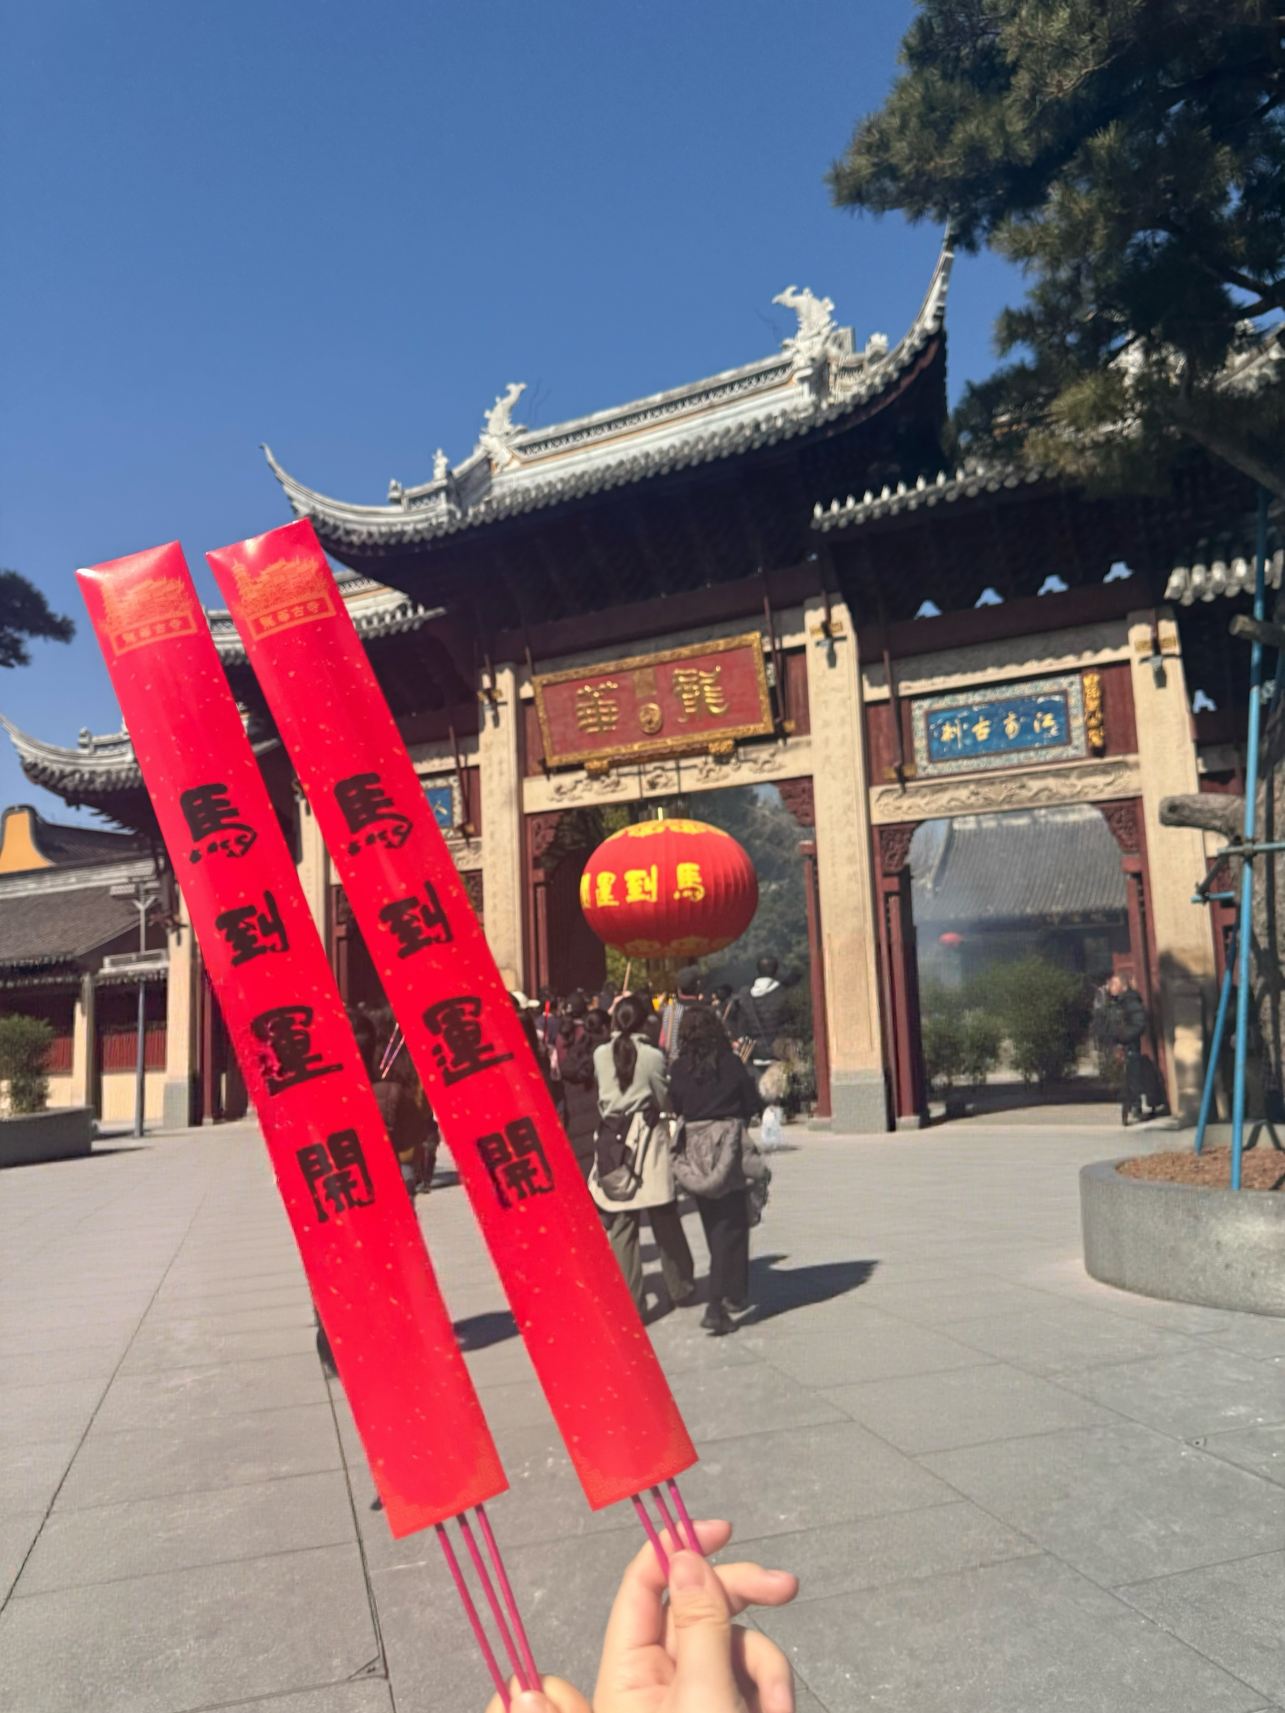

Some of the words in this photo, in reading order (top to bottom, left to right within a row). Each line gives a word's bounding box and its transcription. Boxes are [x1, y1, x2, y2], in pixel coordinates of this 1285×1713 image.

[179, 782, 375, 1222] 馬到運開
[333, 772, 554, 1209] 馬到運開
